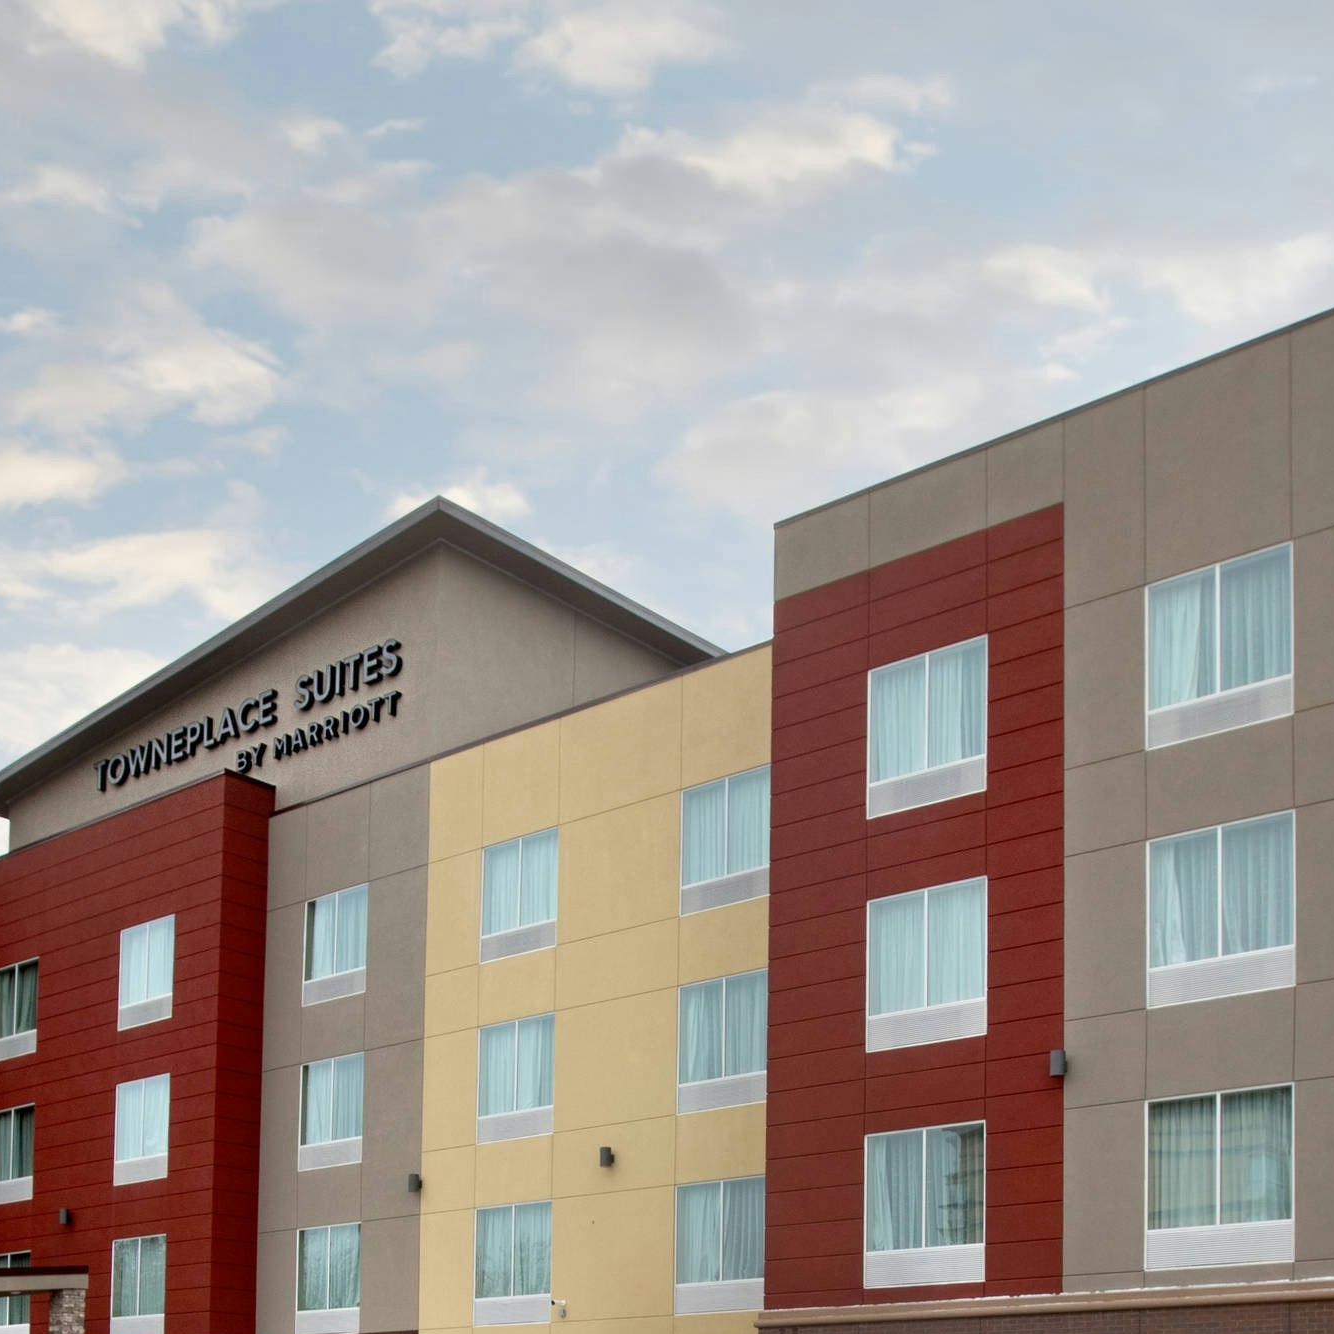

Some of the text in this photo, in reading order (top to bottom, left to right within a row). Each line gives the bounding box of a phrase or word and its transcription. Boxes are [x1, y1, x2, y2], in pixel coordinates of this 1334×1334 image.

[93, 638, 403, 792] TOWNEPLACE SUITES
[235, 690, 402, 774] BY MARRIOTT
